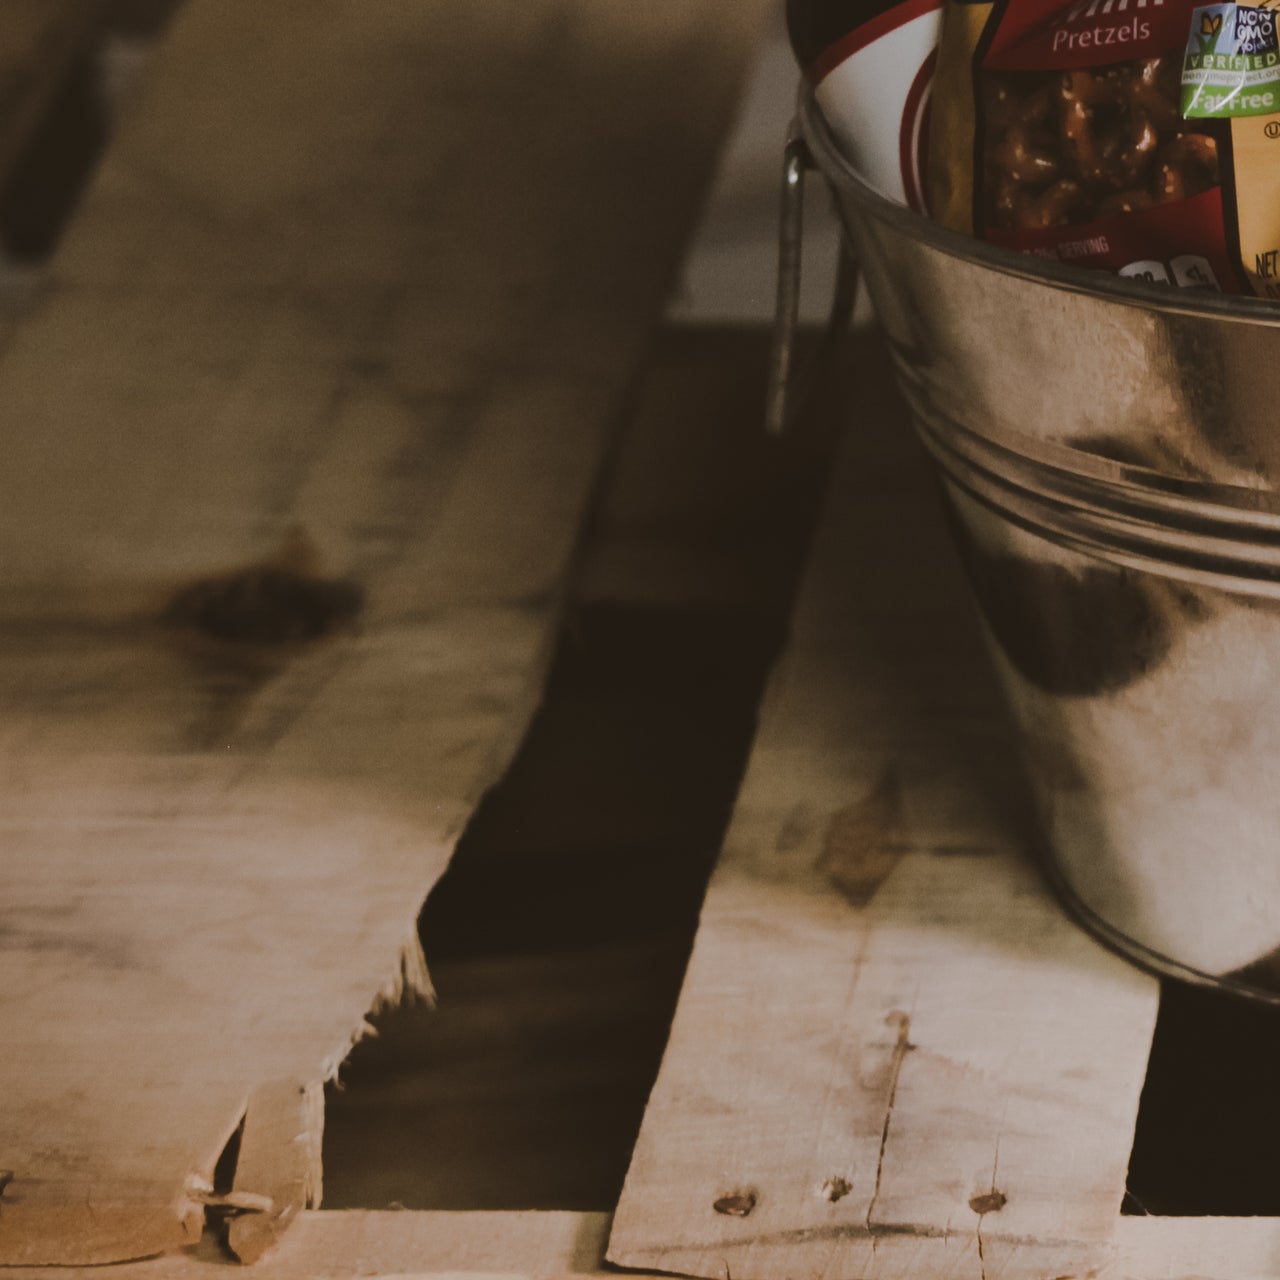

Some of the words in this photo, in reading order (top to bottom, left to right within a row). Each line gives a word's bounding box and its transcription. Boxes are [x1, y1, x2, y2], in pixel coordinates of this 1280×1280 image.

[1053, 18, 1150, 51] Pretzels
[1190, 53, 1277, 70] VERIFIED
[1229, 92, 1274, 110] Free
[1256, 250, 1280, 280] NET
